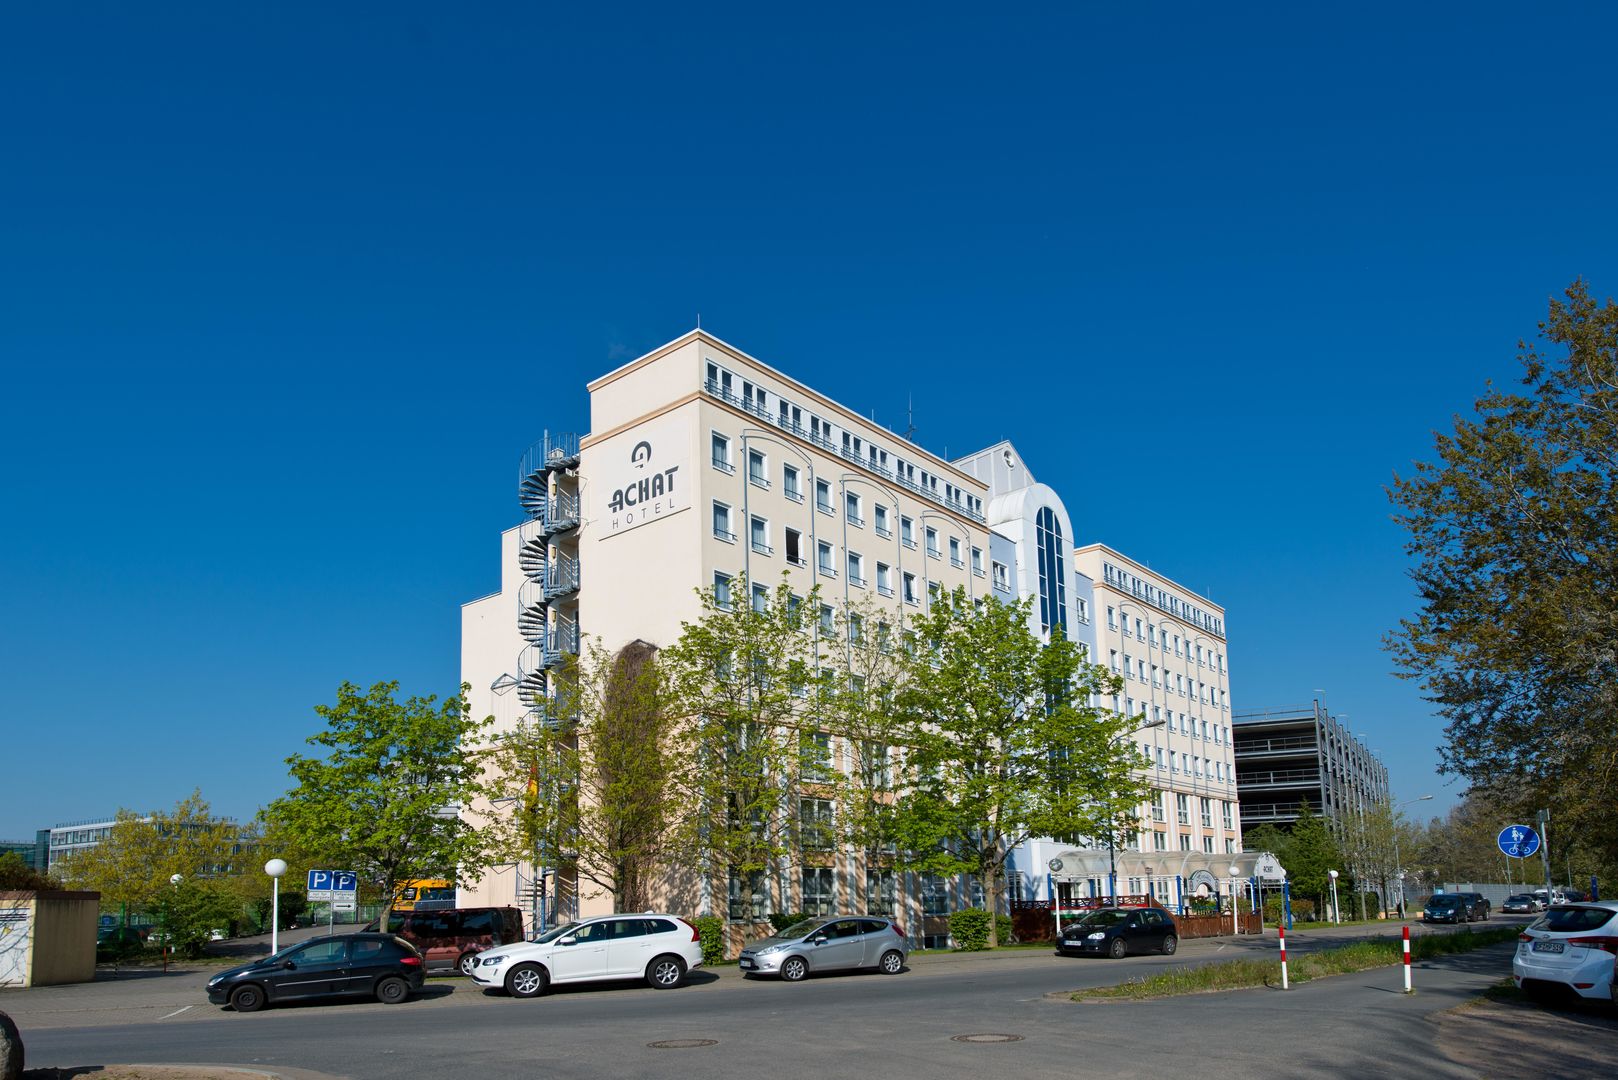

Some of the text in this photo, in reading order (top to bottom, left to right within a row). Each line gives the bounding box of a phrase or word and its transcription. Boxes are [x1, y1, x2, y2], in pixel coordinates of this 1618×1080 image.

[608, 465, 679, 513] ACHAT
[613, 498, 675, 529] HOTEL
[313, 872, 327, 888] P
[338, 876, 351, 889] P
